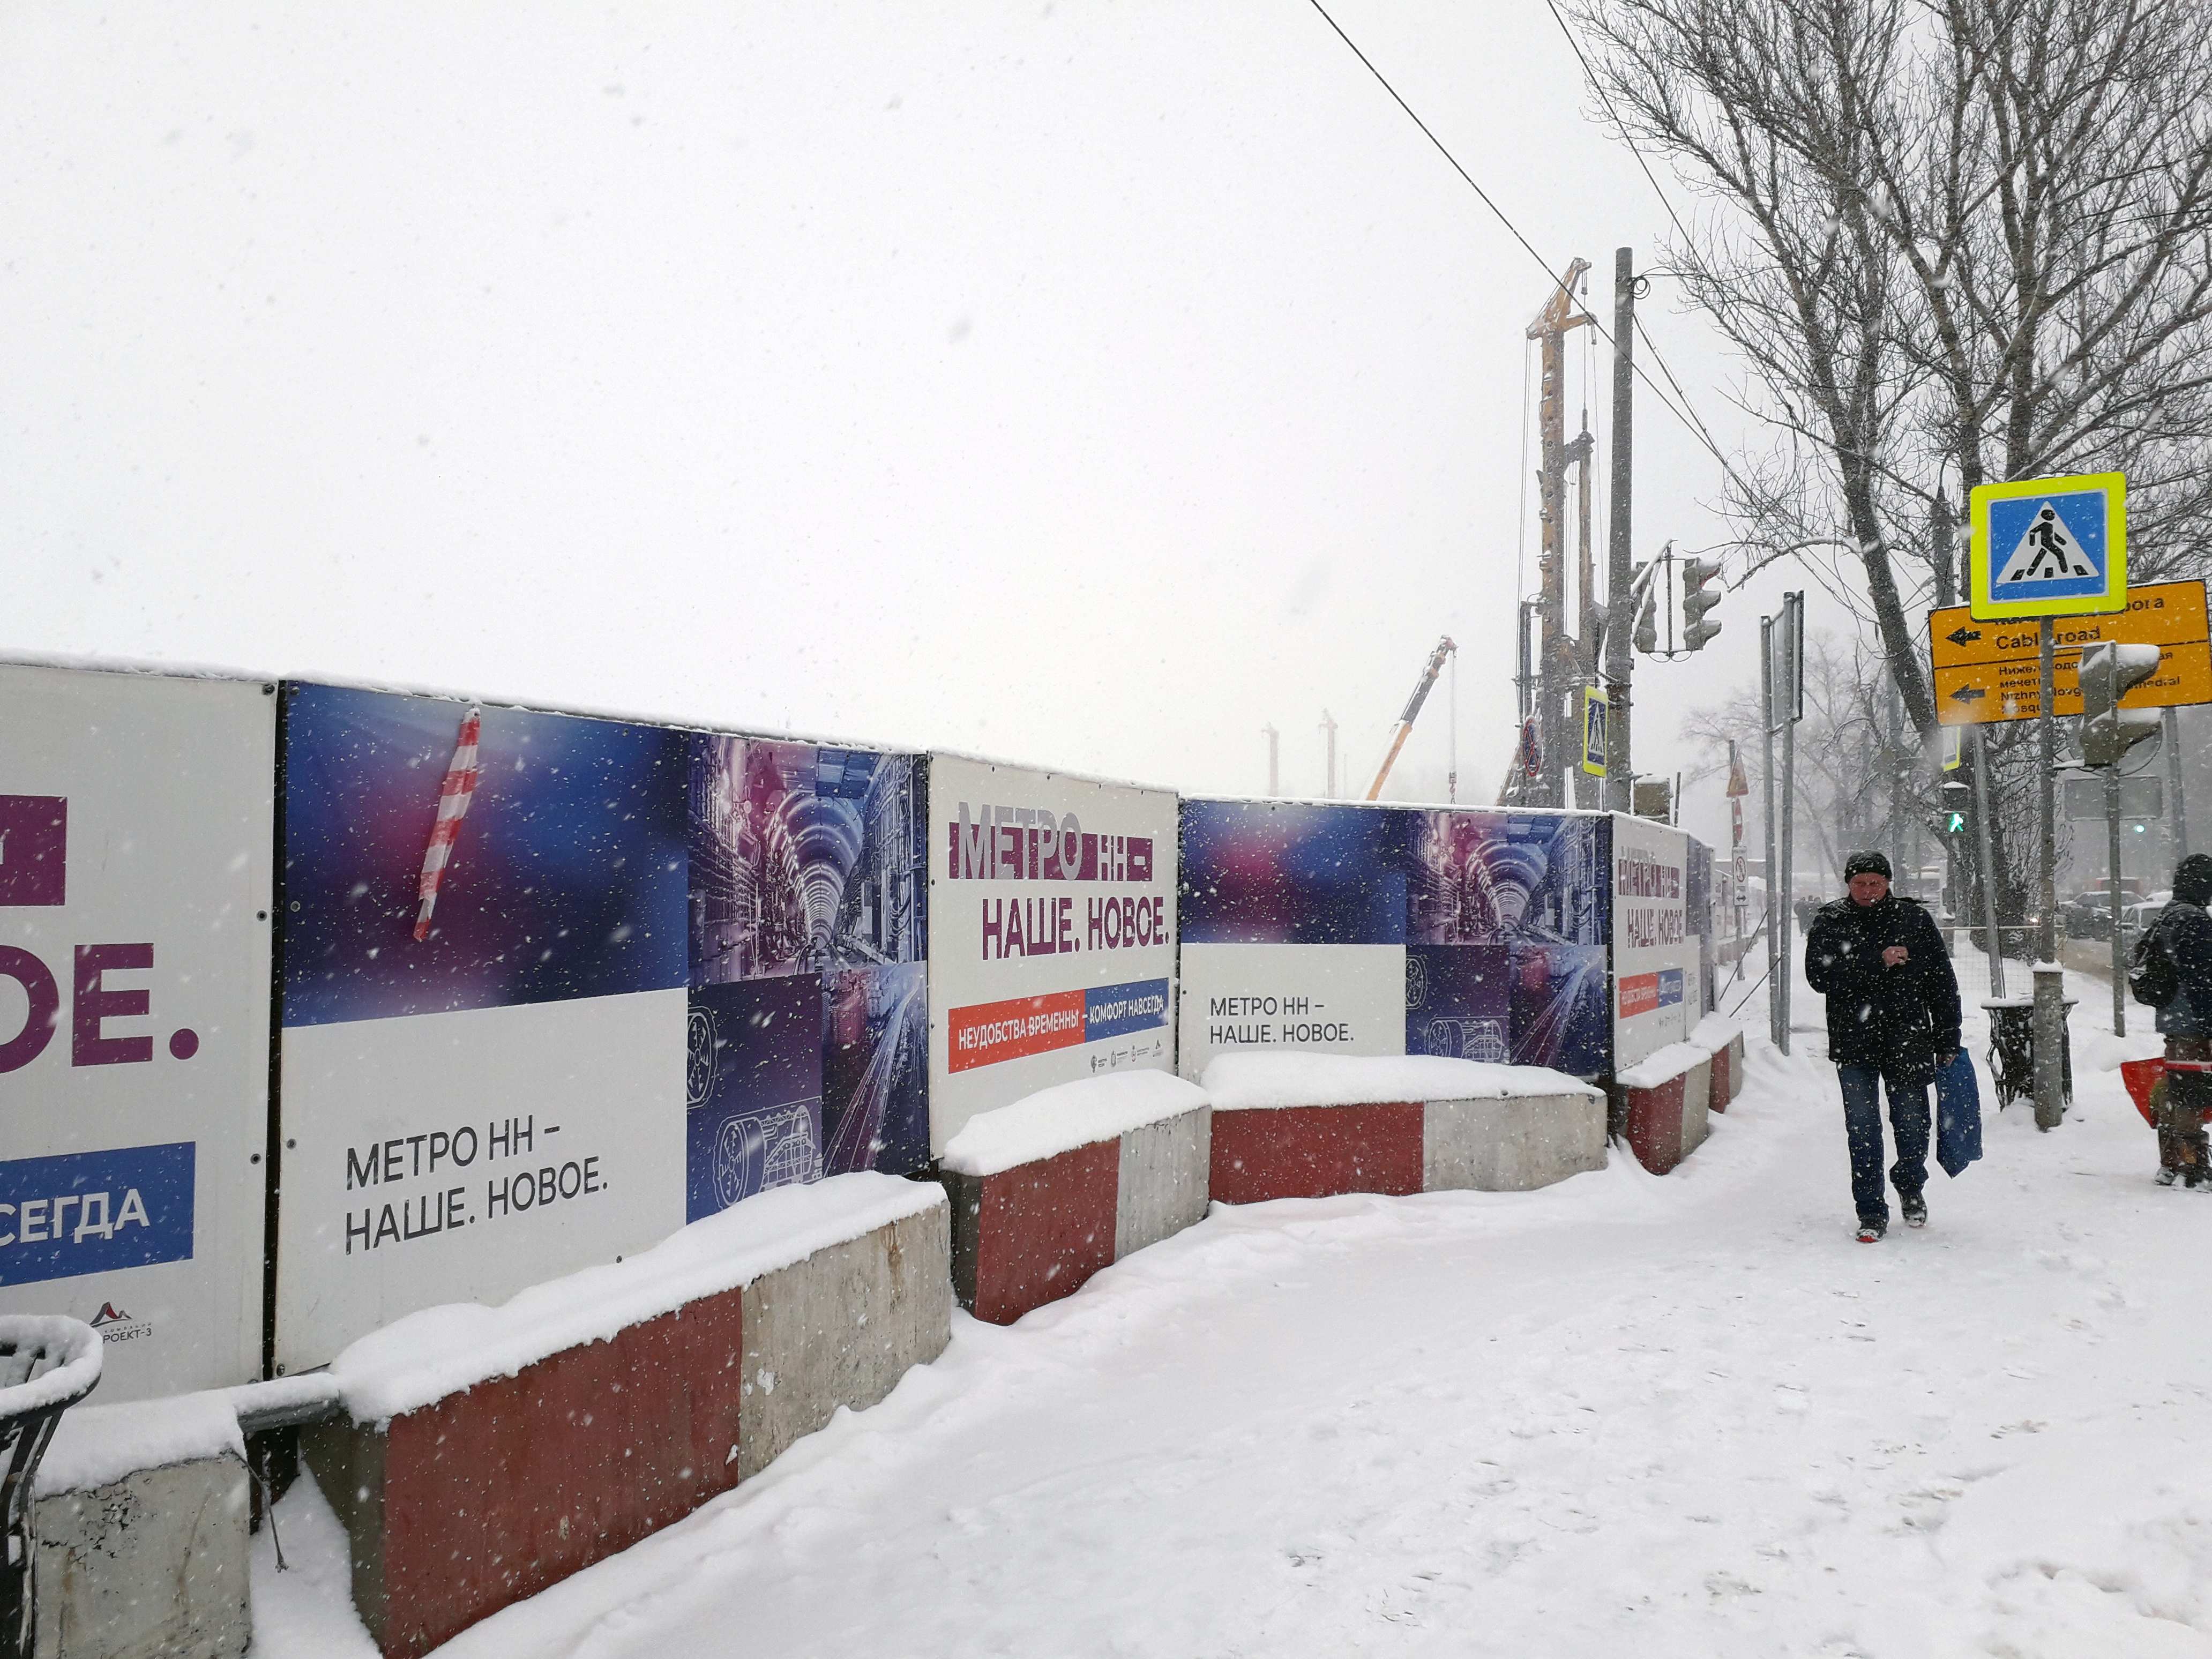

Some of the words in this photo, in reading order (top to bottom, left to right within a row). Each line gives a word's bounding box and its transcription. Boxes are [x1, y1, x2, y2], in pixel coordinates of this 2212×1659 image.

[1996, 632, 2039, 649] Cabl
[2056, 626, 2101, 644] road
[959, 801, 1082, 881] МЕТРО
[1097, 834, 1124, 881] НН
[982, 897, 1080, 960] НАШЕ.
[1088, 896, 1169, 951] НОВОЕ.
[959, 1019, 1026, 1051] НЕУДОБСТВА
[1028, 1009, 1080, 1036] ВРЕМЕННЫ
[1089, 1000, 1127, 1025] КОМФОРТ
[1128, 994, 1164, 1017] НАВСЕГДА
[1210, 997, 1277, 1016] МЕТРО
[1283, 996, 1309, 1015] НН
[1210, 1024, 1277, 1044] НАШЕ.
[1283, 1022, 1354, 1043] НОВОЕ.
[347, 1126, 478, 1191] МЕТРО
[489, 1114, 533, 1160] НН
[345, 1186, 475, 1256] НАШЕ.
[488, 1156, 608, 1219] НОВОЕ.
[102, 1327, 152, 1344] РОЕКТ-3
